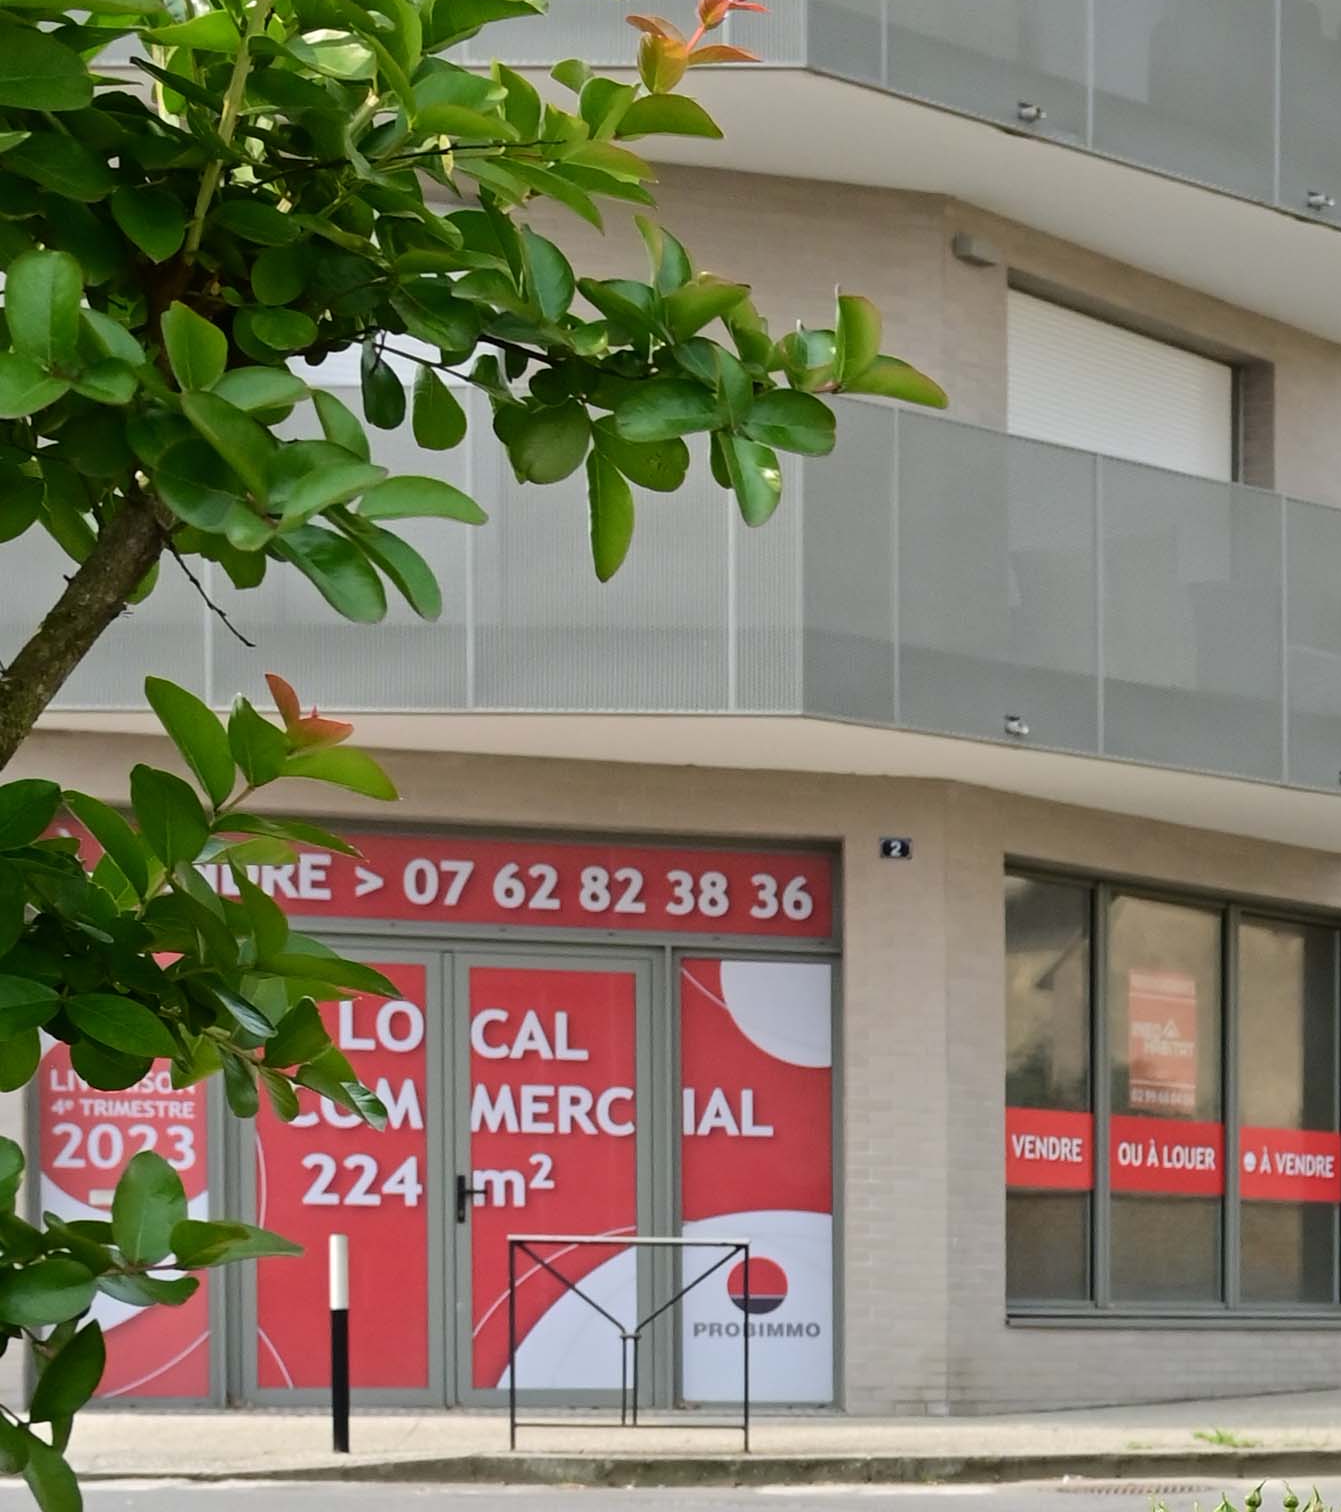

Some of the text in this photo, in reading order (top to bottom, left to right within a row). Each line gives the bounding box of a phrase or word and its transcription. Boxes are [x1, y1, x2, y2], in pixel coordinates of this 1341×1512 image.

[890, 840, 902, 857] 2
[404, 859, 474, 906] 07
[493, 863, 560, 910] 62
[579, 865, 646, 914] 82
[666, 870, 730, 918] 38
[749, 874, 813, 921] 36
[80, 1099, 196, 1120] TRIMESTRE
[52, 1122, 196, 1171] 2023
[1012, 1134, 1083, 1162] VENDRE
[1118, 1138, 1216, 1171] OU À LOUER
[1260, 1145, 1335, 1178] À VENDRE
[302, 1154, 422, 1208] 224
[693, 1322, 821, 1338] PROBIMMO
